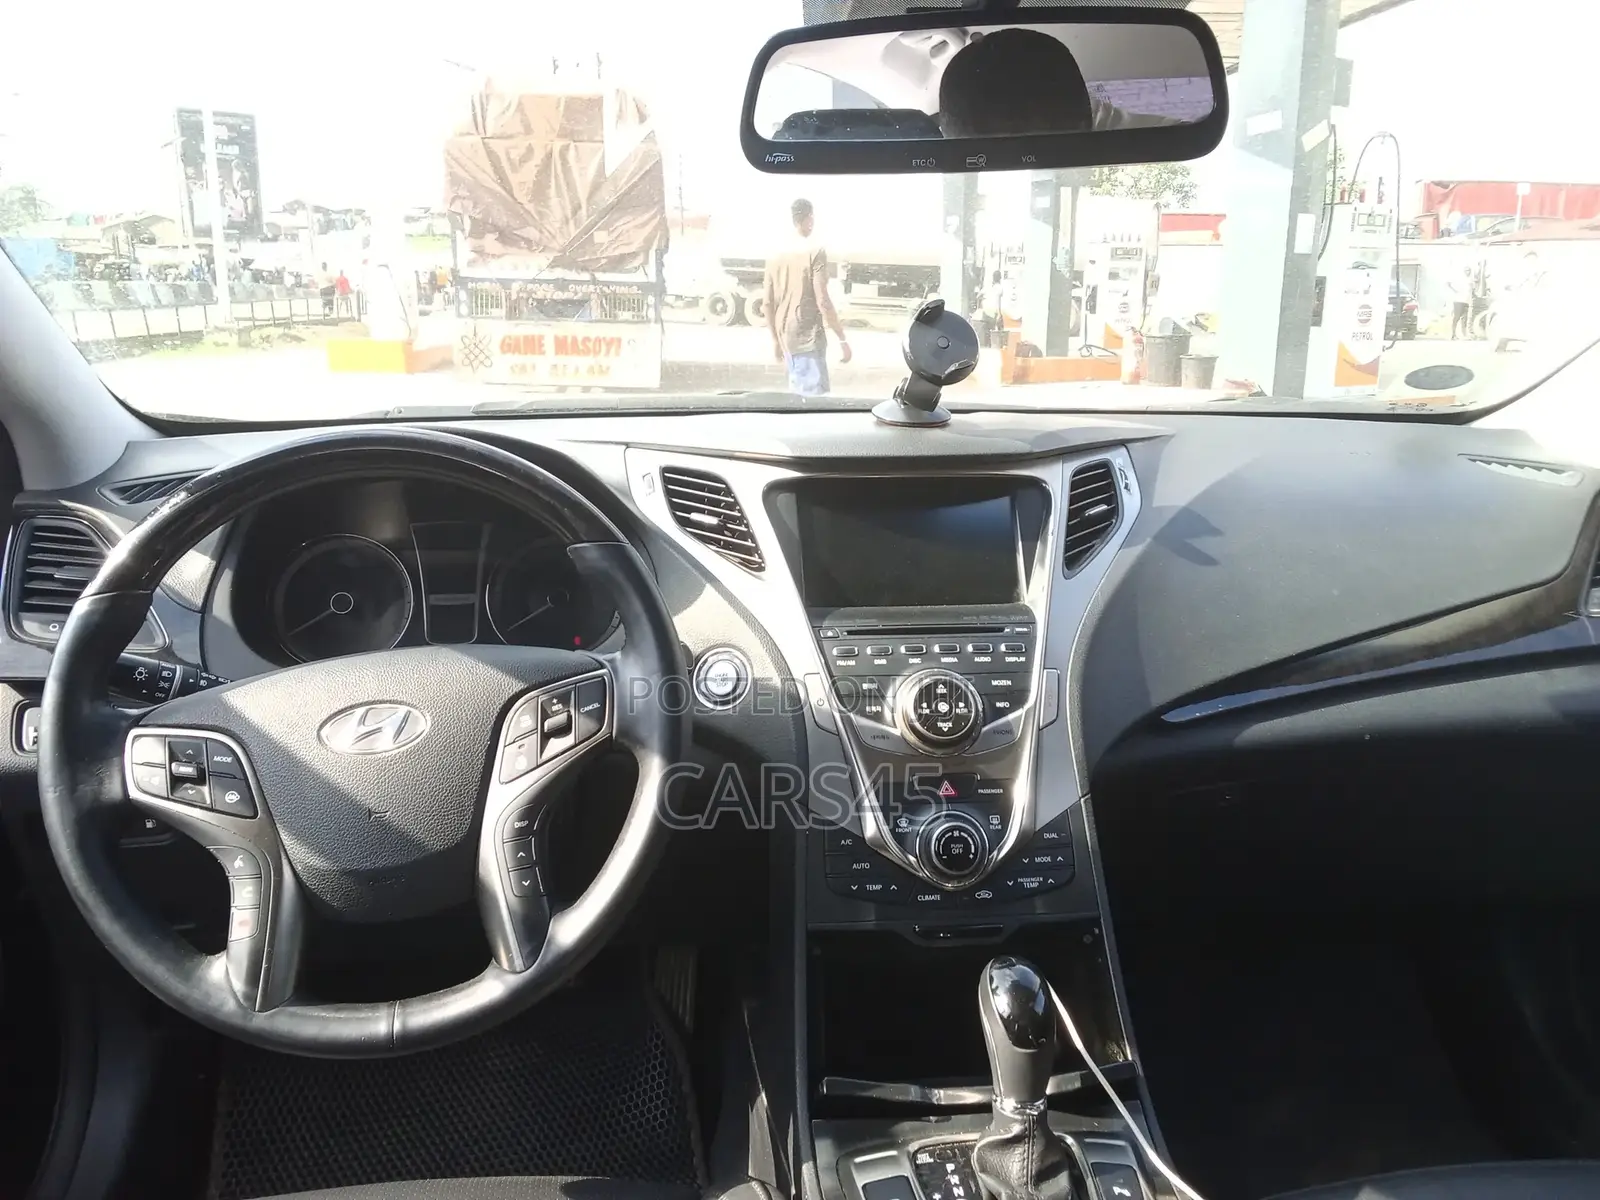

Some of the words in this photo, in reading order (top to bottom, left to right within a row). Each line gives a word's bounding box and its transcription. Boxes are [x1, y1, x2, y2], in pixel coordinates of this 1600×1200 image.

[912, 159, 926, 167] ETC
[1021, 155, 1036, 163] VOL
[1352, 331, 1373, 341] PETROL
[580, 702, 601, 713] CANCEL
[213, 755, 233, 763] MODE
[514, 820, 529, 829] DISP
[945, 1163, 955, 1174] P
[952, 1186, 965, 1197] N
